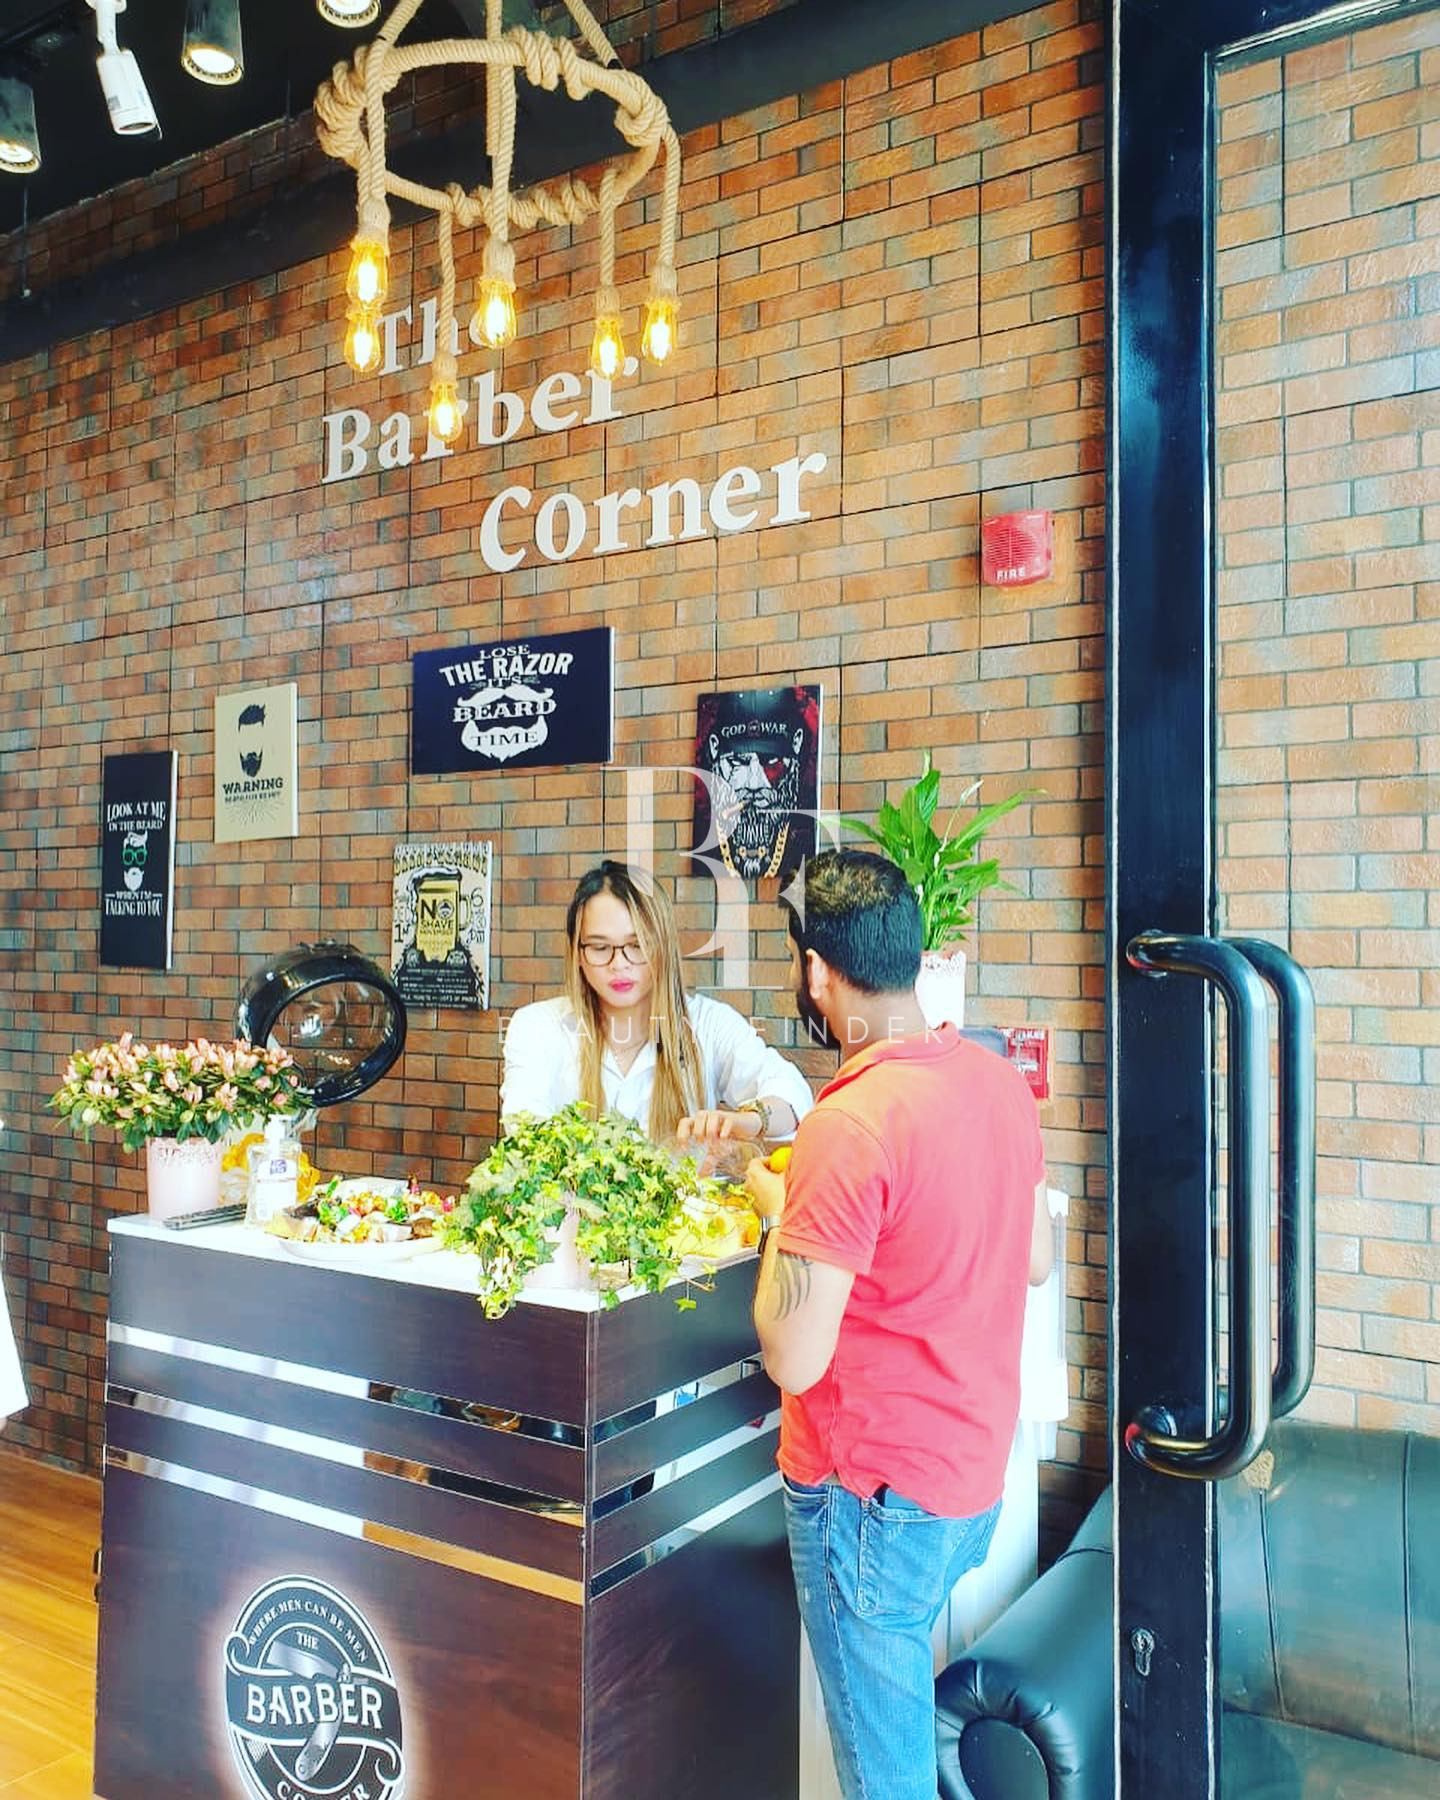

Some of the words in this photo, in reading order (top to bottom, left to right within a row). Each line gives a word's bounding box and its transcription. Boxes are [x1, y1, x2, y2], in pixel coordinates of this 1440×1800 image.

[321, 356, 639, 484] Barber
[480, 452, 828, 572] Corner
[996, 567, 1025, 580] FIRE
[480, 644, 530, 660] LOSE
[439, 660, 486, 686] THE
[493, 653, 573, 679] RAZOR
[487, 675, 523, 688] IT'S
[453, 698, 557, 722] BEARD
[471, 731, 539, 746] TIME
[721, 723, 746, 738] GOD
[760, 721, 788, 738] WAR
[222, 777, 284, 795] WARNING
[106, 802, 133, 823] LOOK
[134, 801, 148, 816] AT
[150, 801, 166, 821] ME
[108, 822, 118, 832] IN
[119, 820, 135, 832] THE
[136, 819, 163, 831] BEARD
[105, 898, 136, 916] TALKING
[420, 919, 455, 929] SHAVE
[248, 1606, 279, 1646] WHERE
[278, 1599, 302, 1613] MEN
[304, 1600, 329, 1619] CAN
[329, 1614, 344, 1632] BE
[345, 1627, 369, 1663] MEN
[295, 1630, 319, 1650] THE
[246, 1683, 383, 1730] BARBER
